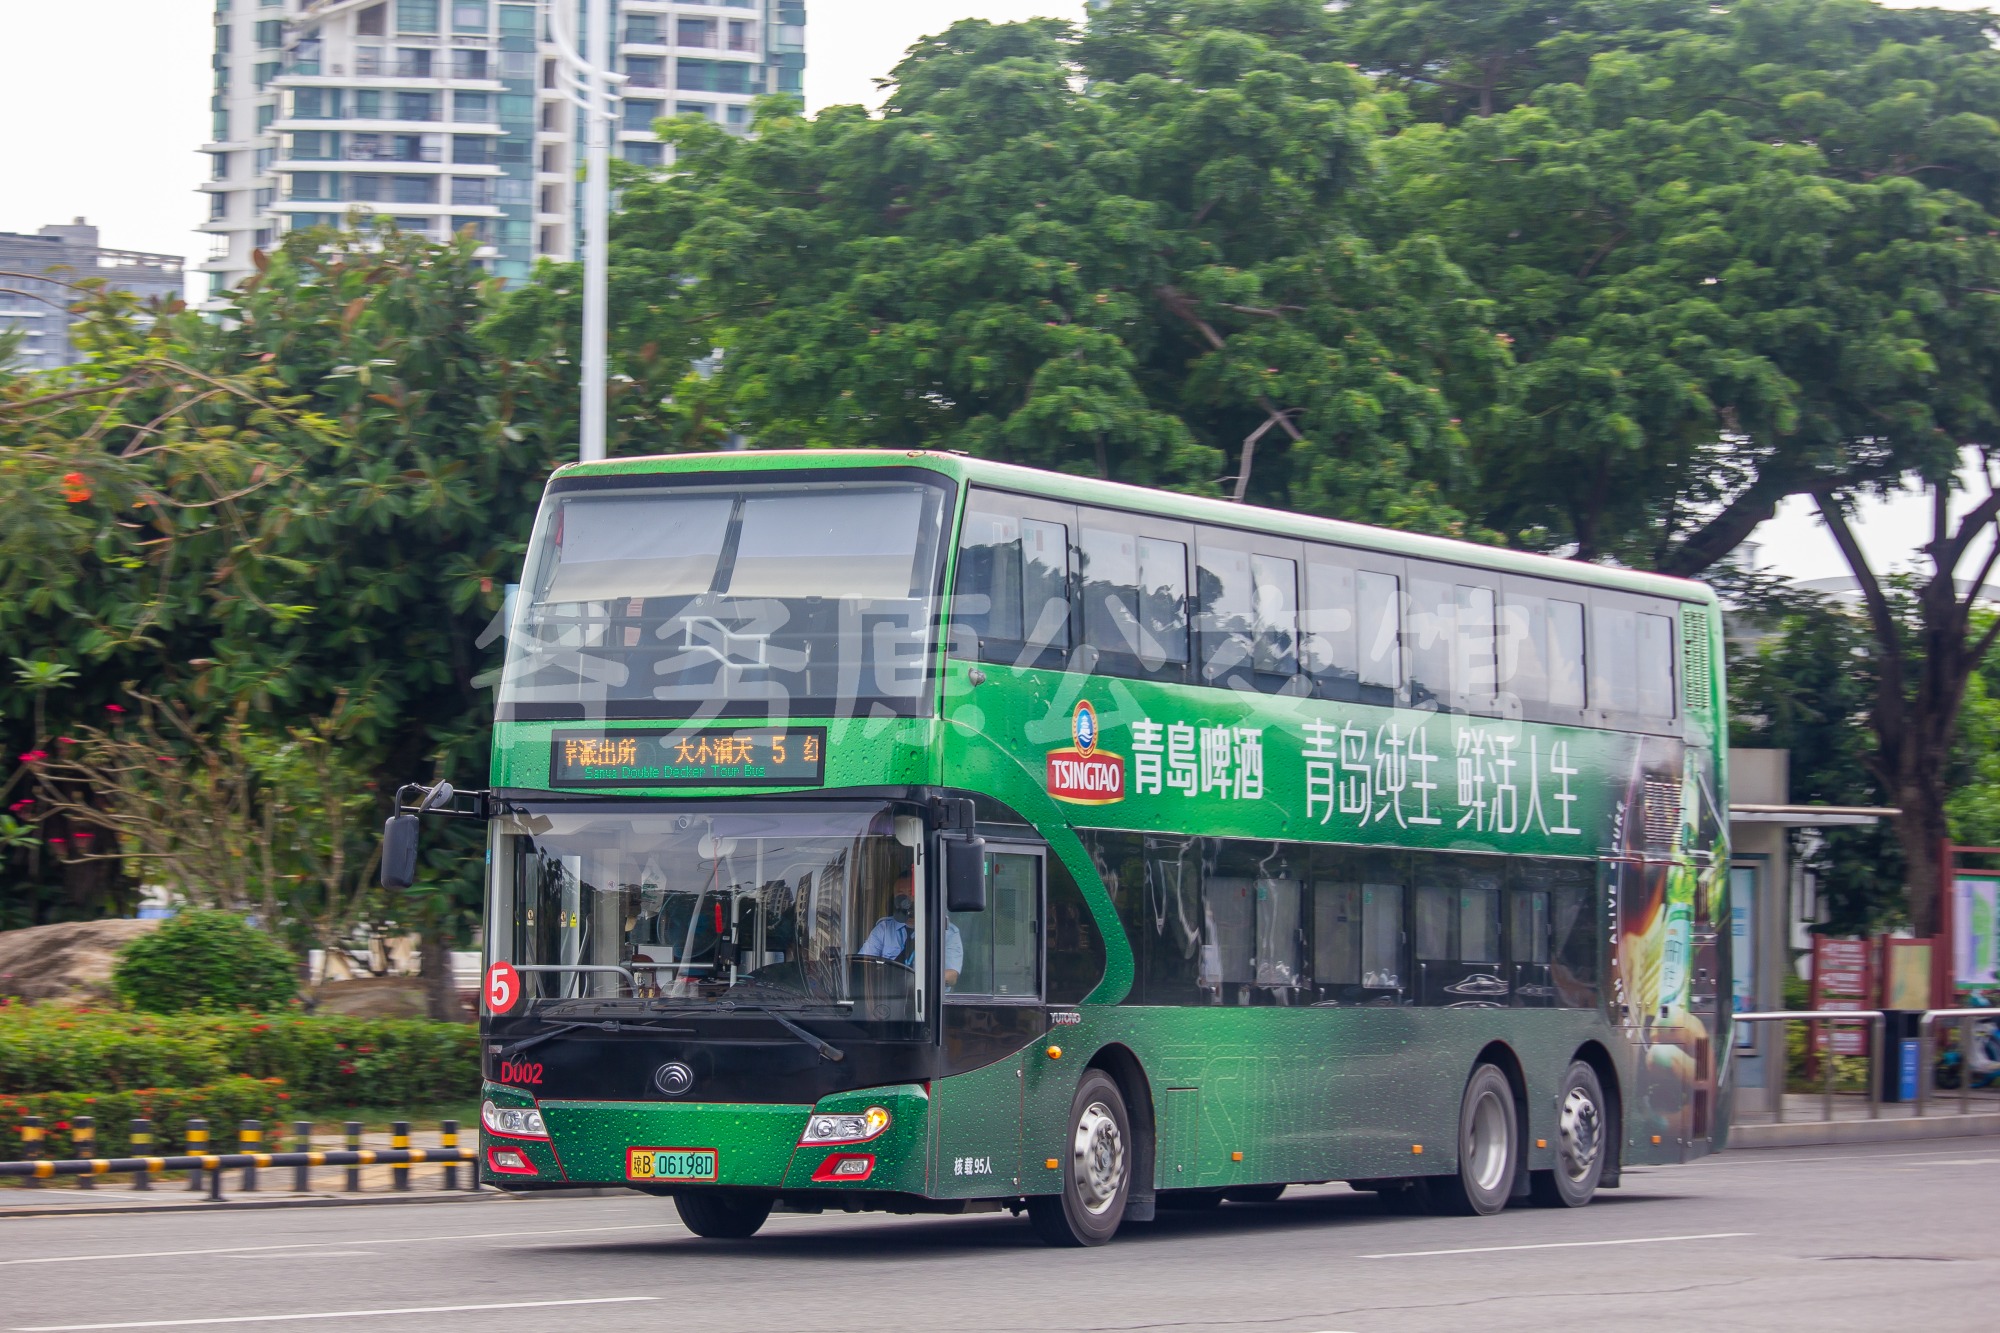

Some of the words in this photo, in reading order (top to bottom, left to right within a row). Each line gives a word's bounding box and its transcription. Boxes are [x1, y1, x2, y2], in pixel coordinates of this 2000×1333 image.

[772, 736, 787, 763] 5
[585, 766, 618, 779] Sanya
[622, 766, 659, 779] Double
[664, 765, 706, 778] Decker
[711, 765, 740, 777] Tour
[745, 765, 766, 777] Bus
[1051, 759, 1121, 793] TSINGTAO
[1301, 717, 1443, 830] 青岛纯生
[1456, 725, 1582, 836] 鲜活人生
[1607, 884, 1617, 944] ALIVE
[491, 968, 510, 1006] 5
[1050, 1012, 1081, 1024] YUTONG
[501, 1062, 543, 1084] D002
[954, 1156, 993, 1176] 核载95人
